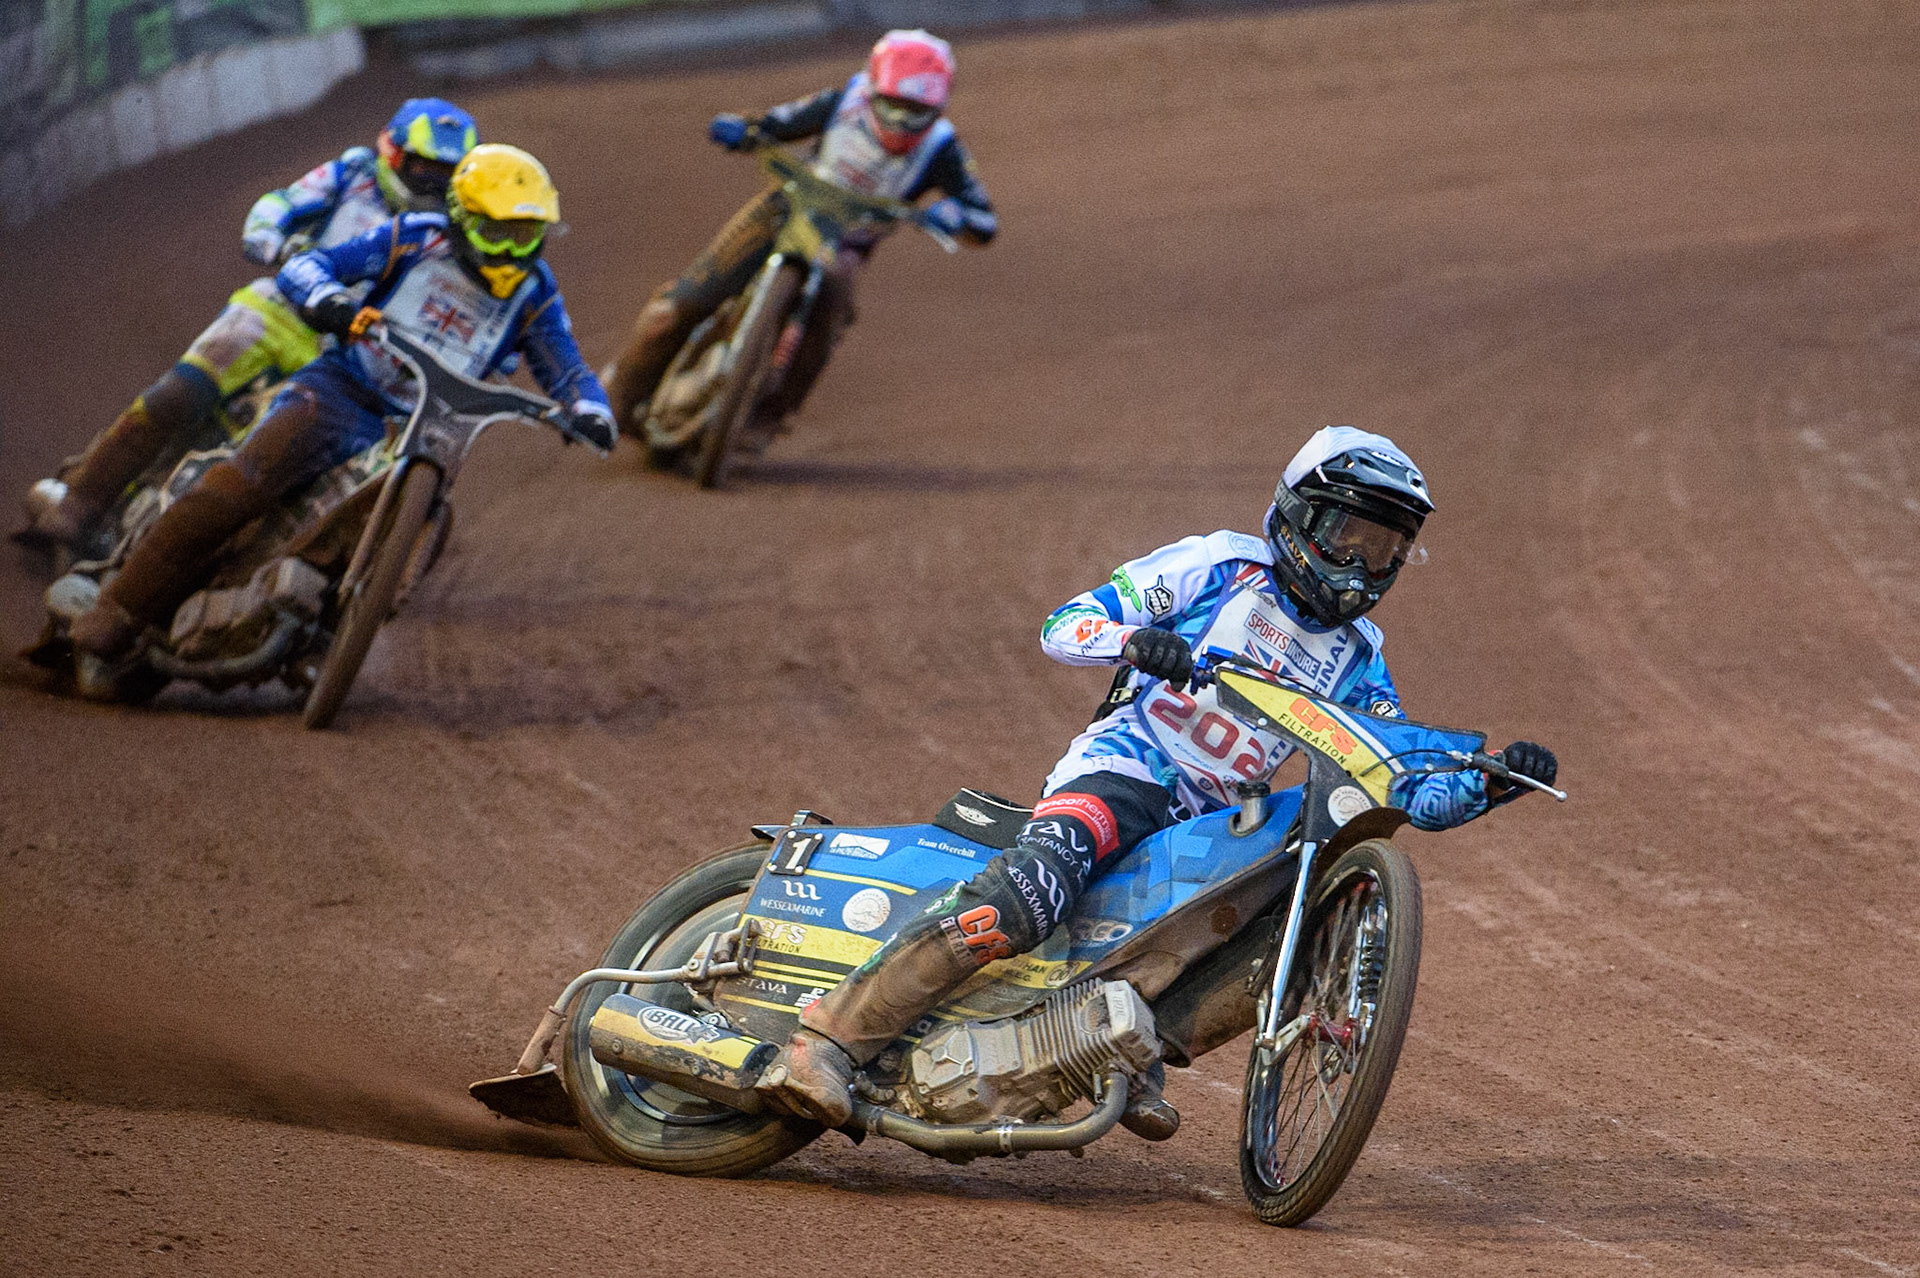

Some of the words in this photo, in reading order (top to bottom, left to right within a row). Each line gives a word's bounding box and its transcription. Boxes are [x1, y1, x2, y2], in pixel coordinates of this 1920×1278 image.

[1247, 612, 1290, 652] SPORTS
[1286, 640, 1319, 679] INSURE
[1278, 713, 1347, 765] FILTRATION
[1289, 698, 1358, 755] CFS
[785, 837, 812, 869] 1
[917, 838, 938, 848] Team
[938, 842, 976, 858] Overchill
[760, 898, 827, 917] WESSEXMARINE
[760, 919, 807, 944] CFS
